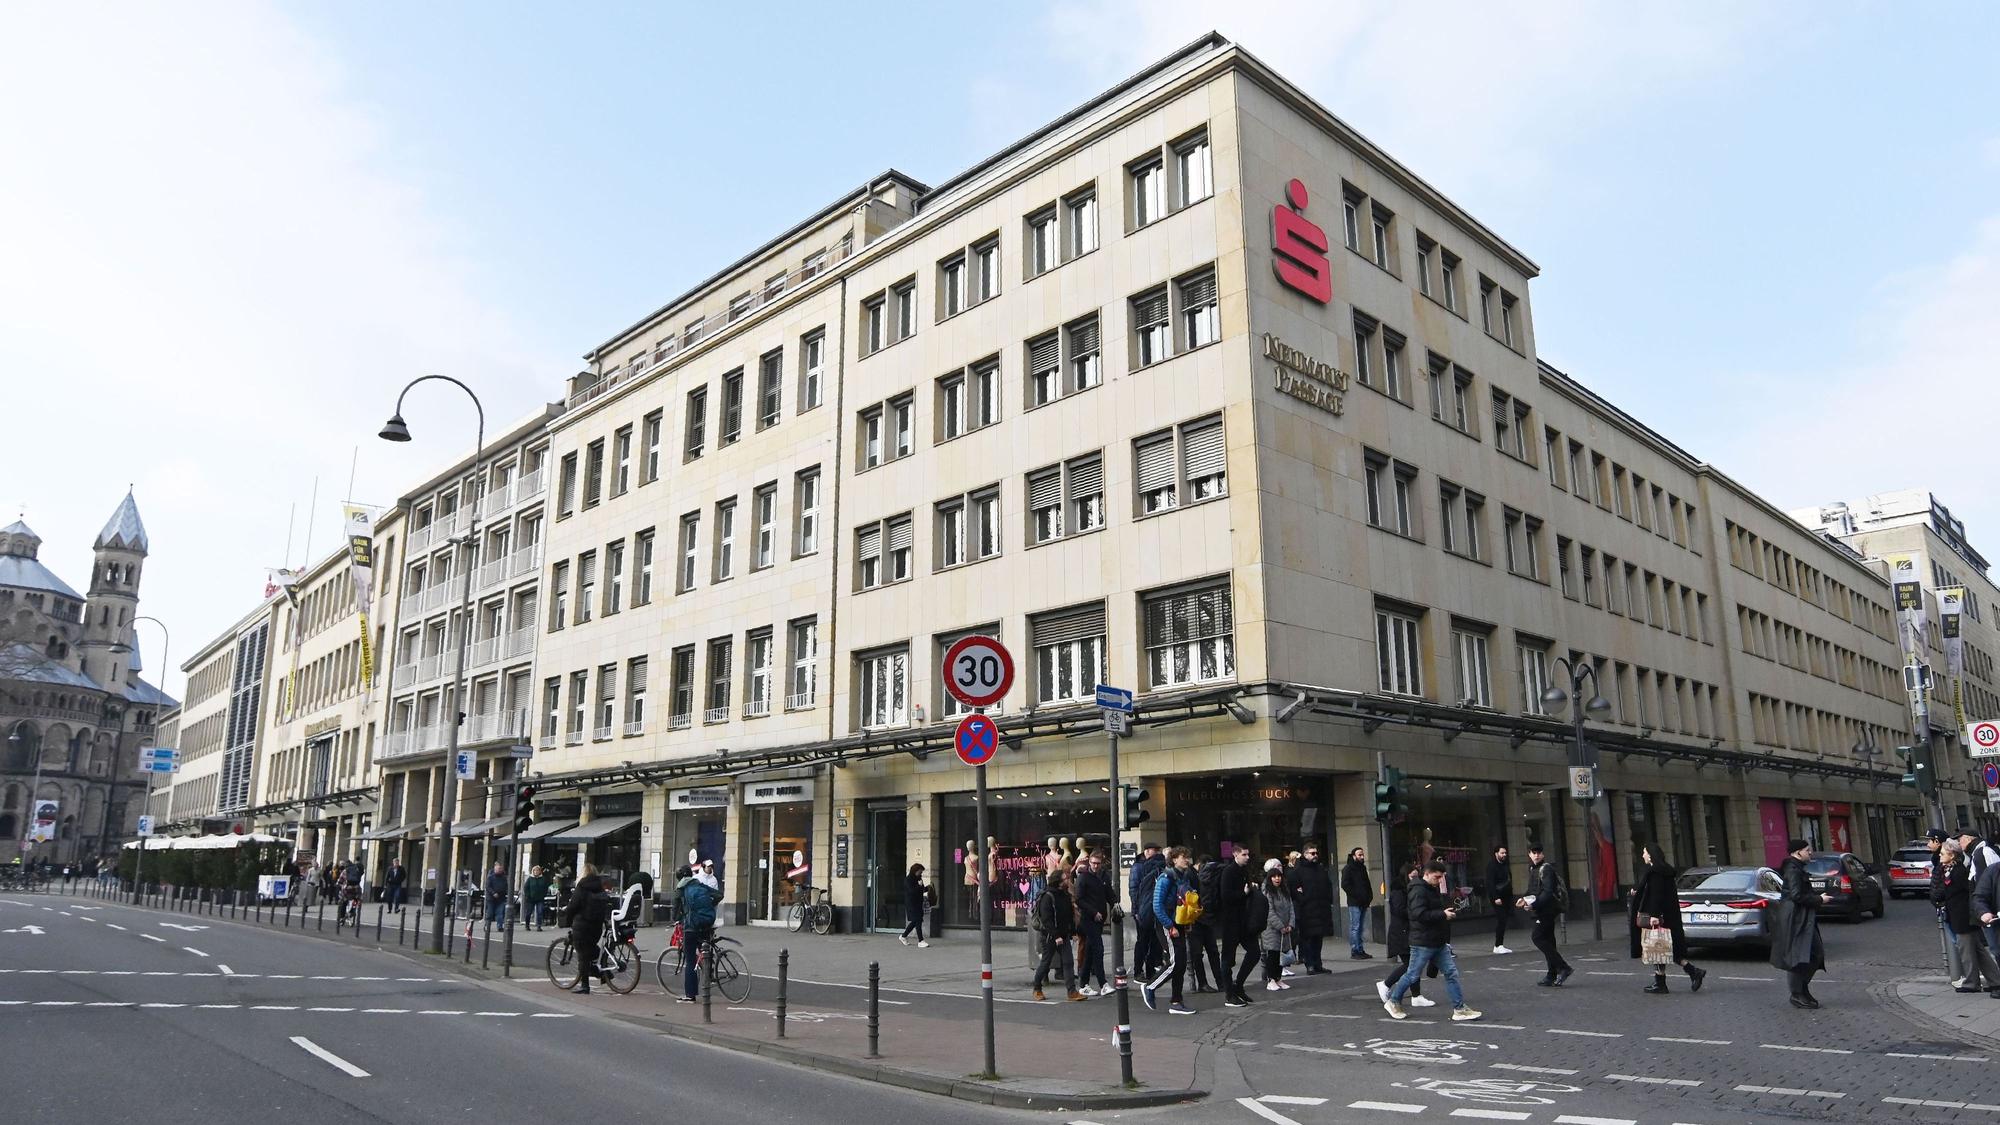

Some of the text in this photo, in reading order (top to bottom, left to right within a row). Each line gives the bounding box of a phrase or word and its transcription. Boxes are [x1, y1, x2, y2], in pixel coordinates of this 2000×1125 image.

[1263, 332, 1350, 393] NEUMARKT
[1274, 365, 1344, 417] PASSAGE
[1899, 592, 1910, 600] FÜR
[1900, 599, 1917, 607] NEUES
[957, 655, 999, 687] 30
[1978, 729, 1994, 741] 30
[1979, 747, 1999, 755] ZONE
[1577, 774, 1588, 784] 30
[1715, 913, 1728, 921] 256
